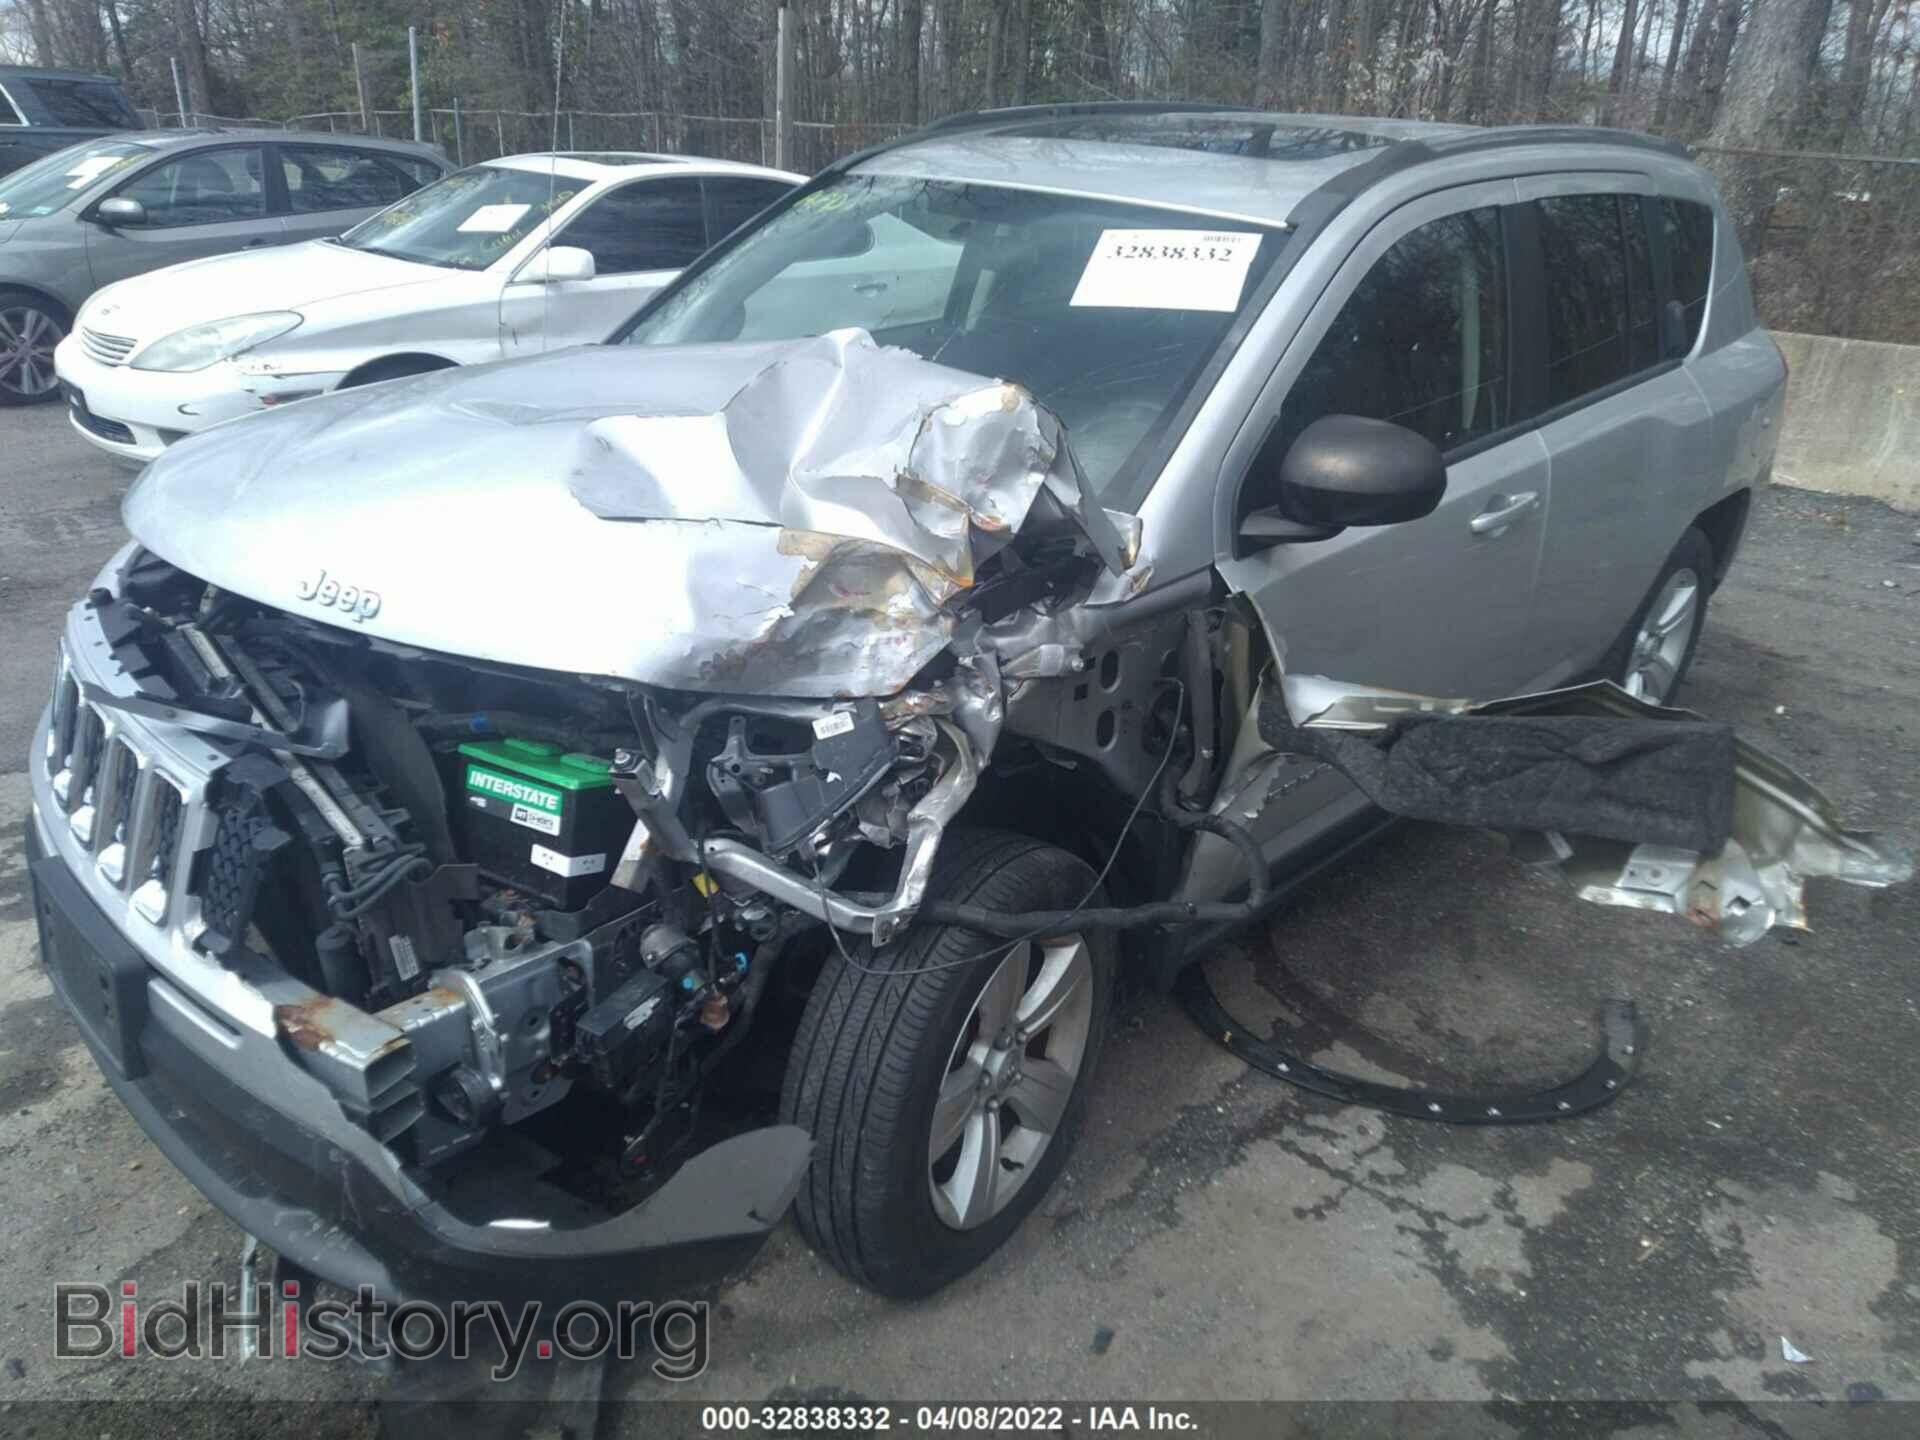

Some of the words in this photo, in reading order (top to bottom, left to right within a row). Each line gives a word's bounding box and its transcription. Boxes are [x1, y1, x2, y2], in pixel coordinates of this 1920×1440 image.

[1105, 244, 1233, 262] 32838332
[295, 567, 382, 624] Jeep
[469, 770, 560, 811] INTERSTATE
